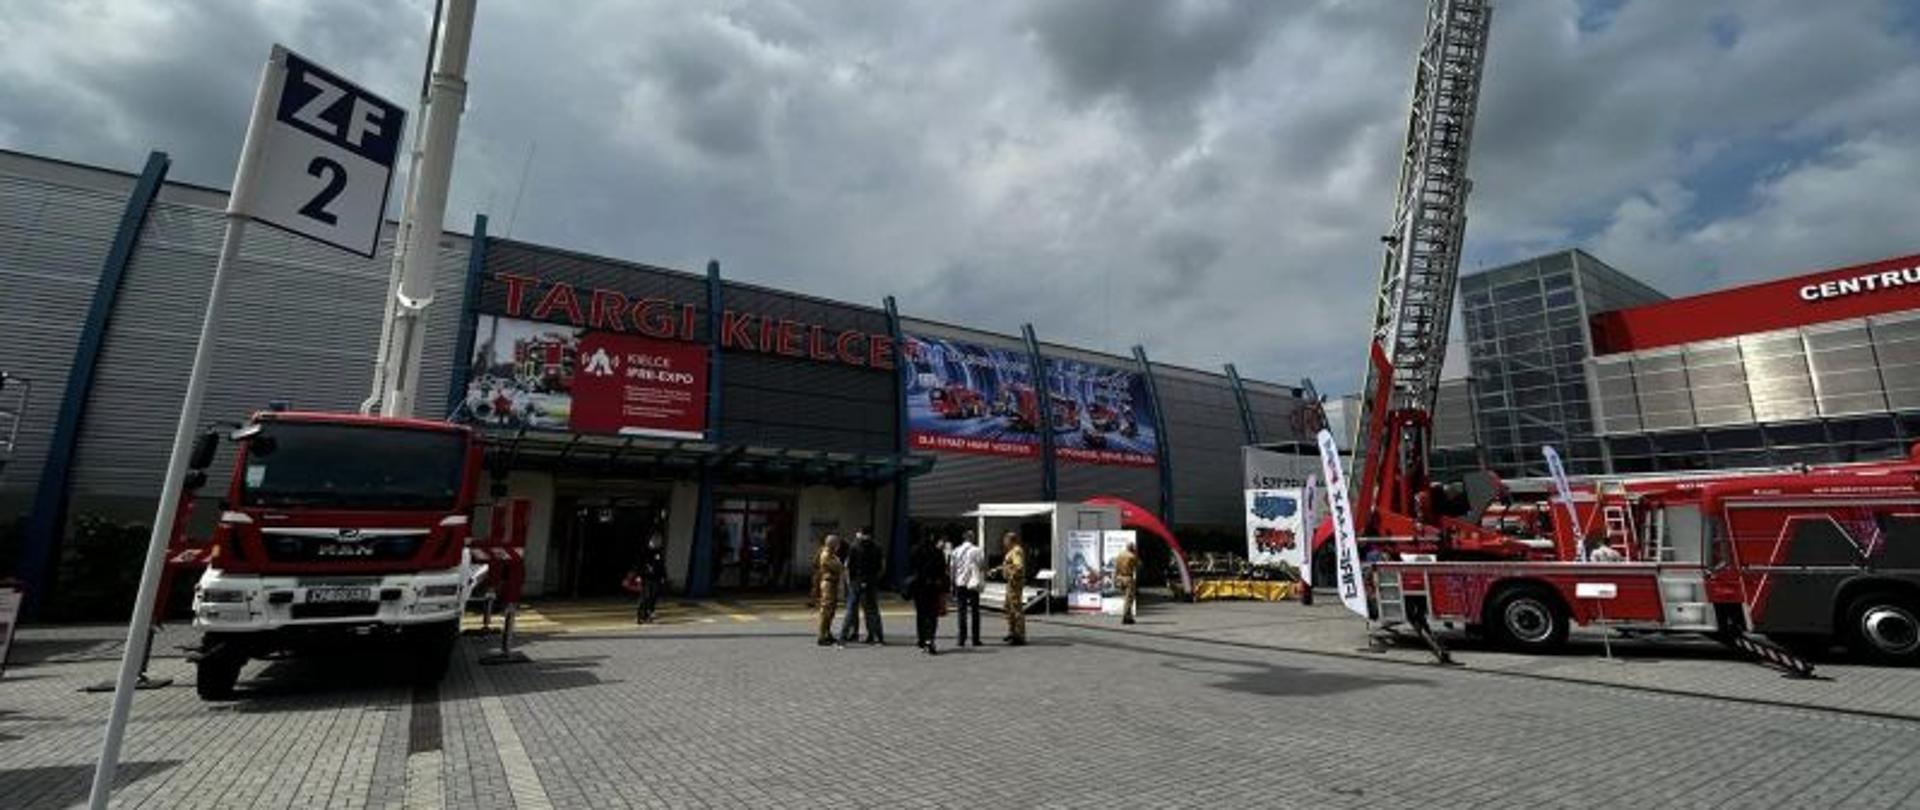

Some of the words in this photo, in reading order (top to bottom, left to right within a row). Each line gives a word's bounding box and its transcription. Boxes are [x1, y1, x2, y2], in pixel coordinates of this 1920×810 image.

[293, 71, 386, 148] ZF
[298, 156, 348, 226] 2
[1799, 266, 1920, 301] CENTRU
[496, 272, 695, 340] TARGI
[722, 310, 892, 368] KIELCE
[627, 353, 671, 368] KIELCE
[317, 544, 376, 556] MAN
